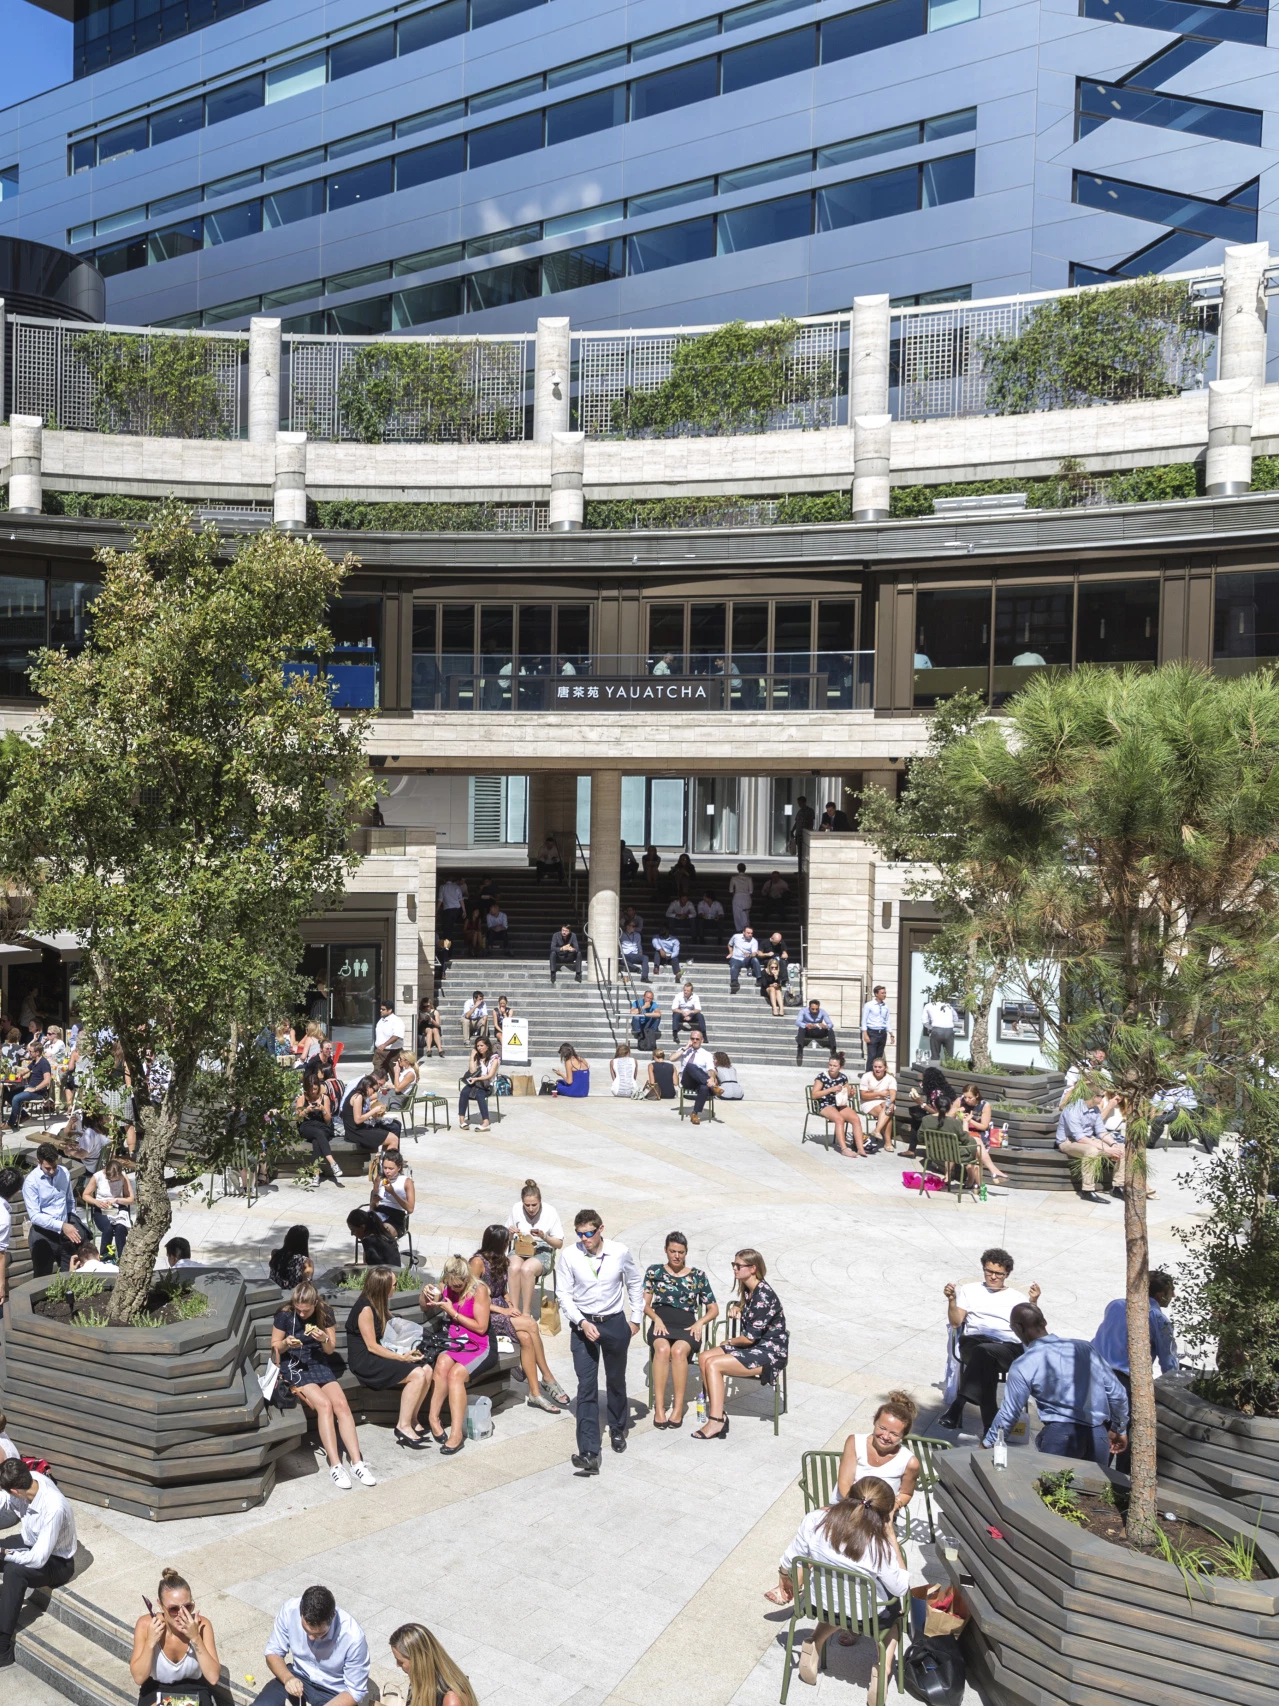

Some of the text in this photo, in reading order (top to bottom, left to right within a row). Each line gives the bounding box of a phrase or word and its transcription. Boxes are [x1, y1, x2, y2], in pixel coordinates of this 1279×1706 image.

[557, 685, 707, 699] 唐茶苑 YAUATCHA
